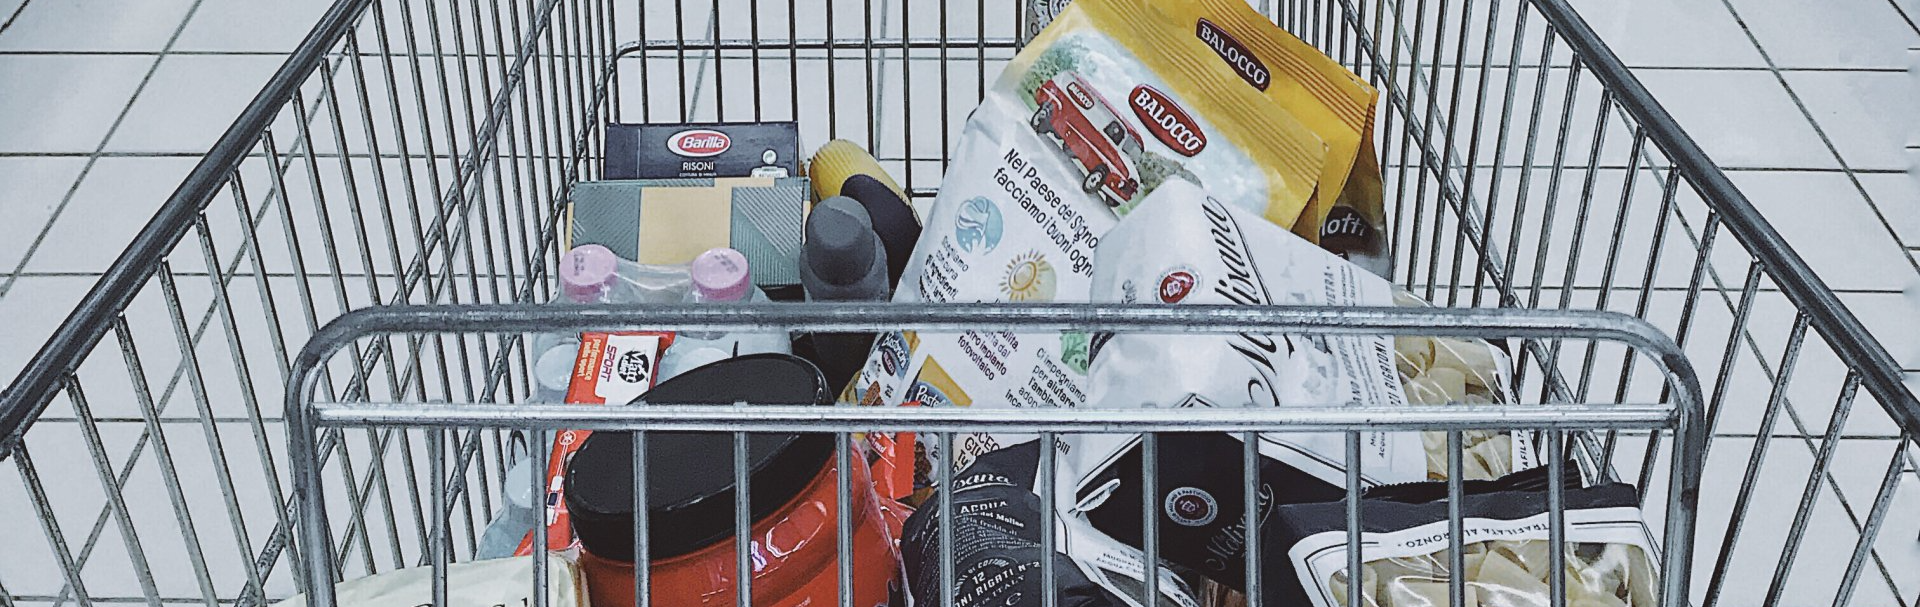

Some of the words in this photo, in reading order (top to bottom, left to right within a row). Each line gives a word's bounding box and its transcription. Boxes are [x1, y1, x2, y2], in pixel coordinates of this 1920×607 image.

[1201, 23, 1267, 85] BALOCCO
[1134, 88, 1203, 151] BALOCCO
[682, 136, 725, 149] Barilla
[683, 162, 714, 171] RISONI
[1003, 147, 1028, 174] Nel
[1022, 166, 1062, 209] Paese
[1057, 203, 1077, 222] del
[993, 167, 1047, 224] facciamo
[1046, 220, 1076, 254] buoni
[957, 334, 996, 381] fotovoltaico
[979, 340, 1007, 376] impianto
[998, 343, 1011, 359] dal
[576, 358, 588, 377] sport
[600, 344, 618, 383] SPORT
[625, 351, 648, 383] Matt
[1032, 365, 1048, 381] per
[1374, 341, 1398, 391] RIGATONI
[995, 513, 1025, 528] Molise
[1464, 528, 1478, 537] AL
[1482, 522, 1550, 537] TRAFILATA
[1405, 531, 1451, 548] RONZO
[972, 571, 986, 585] 12
[975, 568, 1014, 597] RIGATI
